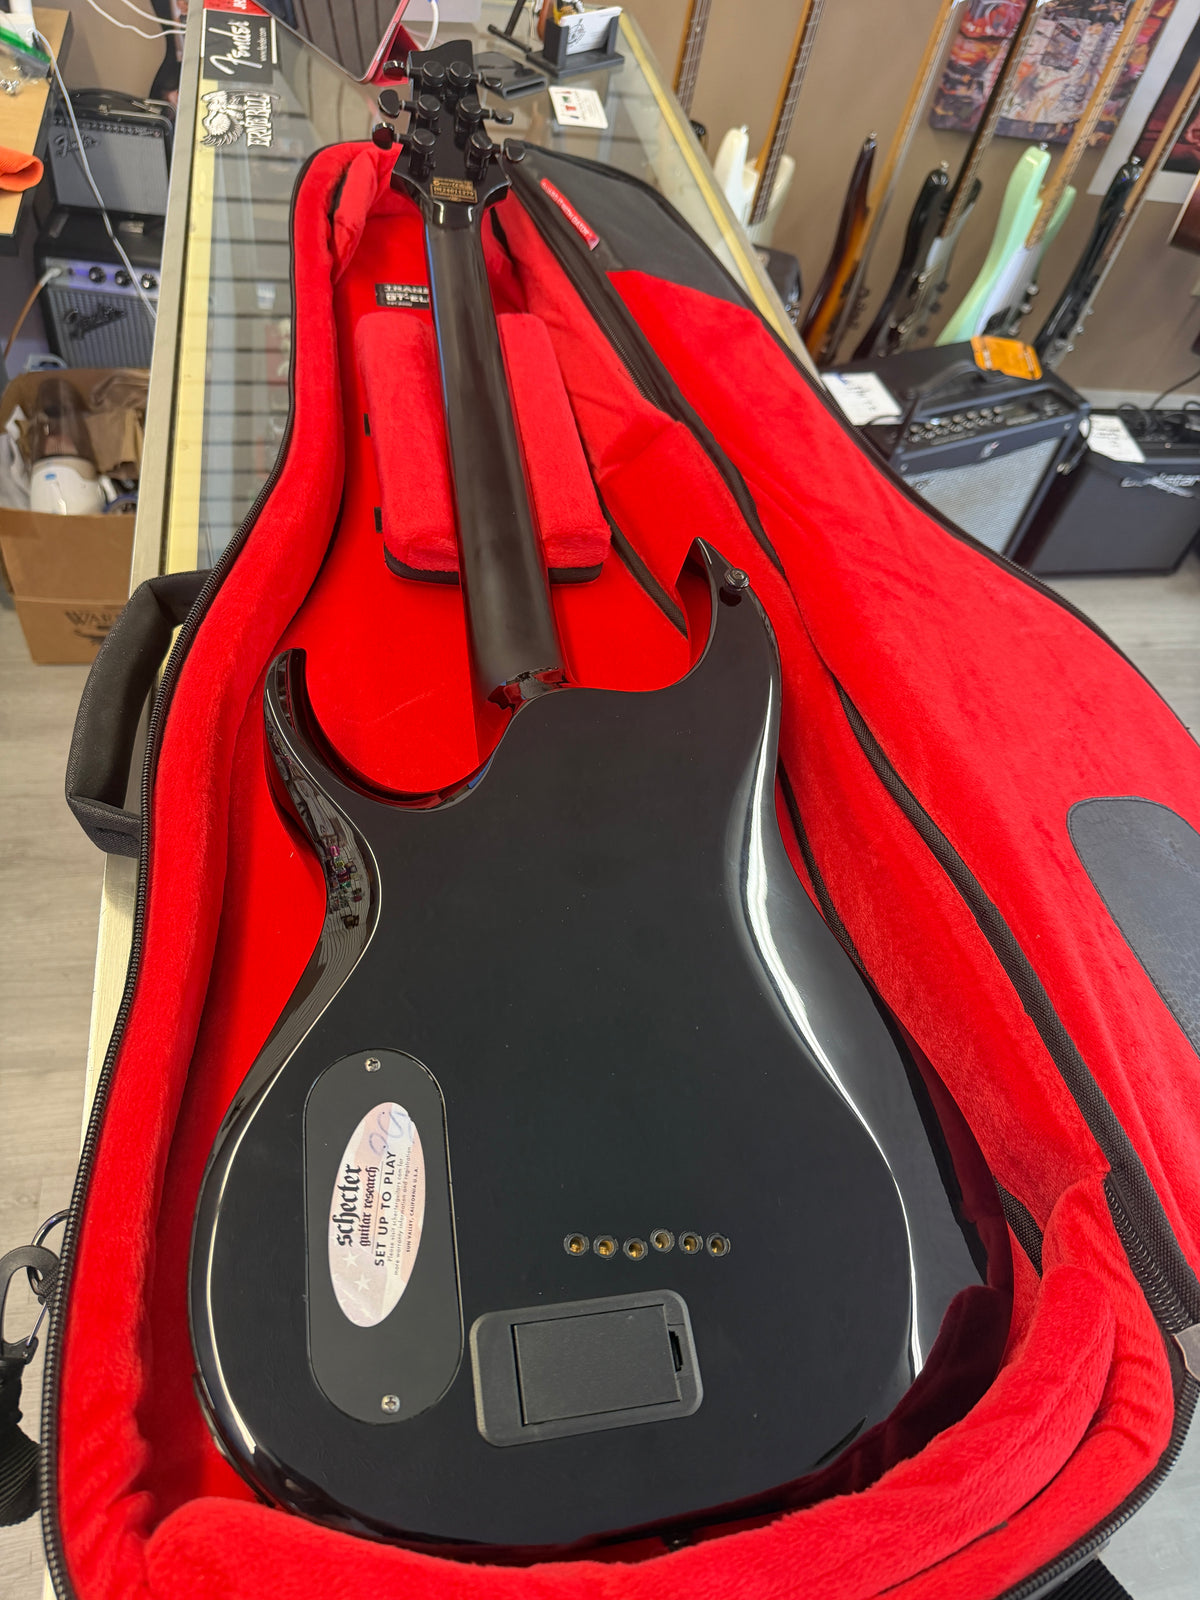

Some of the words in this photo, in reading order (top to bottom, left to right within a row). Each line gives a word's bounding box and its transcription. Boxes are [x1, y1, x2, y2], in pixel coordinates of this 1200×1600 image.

[208, 20, 263, 75] Fender
[244, 94, 272, 118] BALL
[244, 119, 272, 147] ERNIE
[384, 1151, 396, 1184] PLAY
[364, 1166, 379, 1209] research
[381, 1191, 392, 1209] TO
[332, 1163, 362, 1248] schecter
[359, 1212, 372, 1247] guitar
[378, 1216, 389, 1235] UP
[375, 1242, 386, 1267] SET
